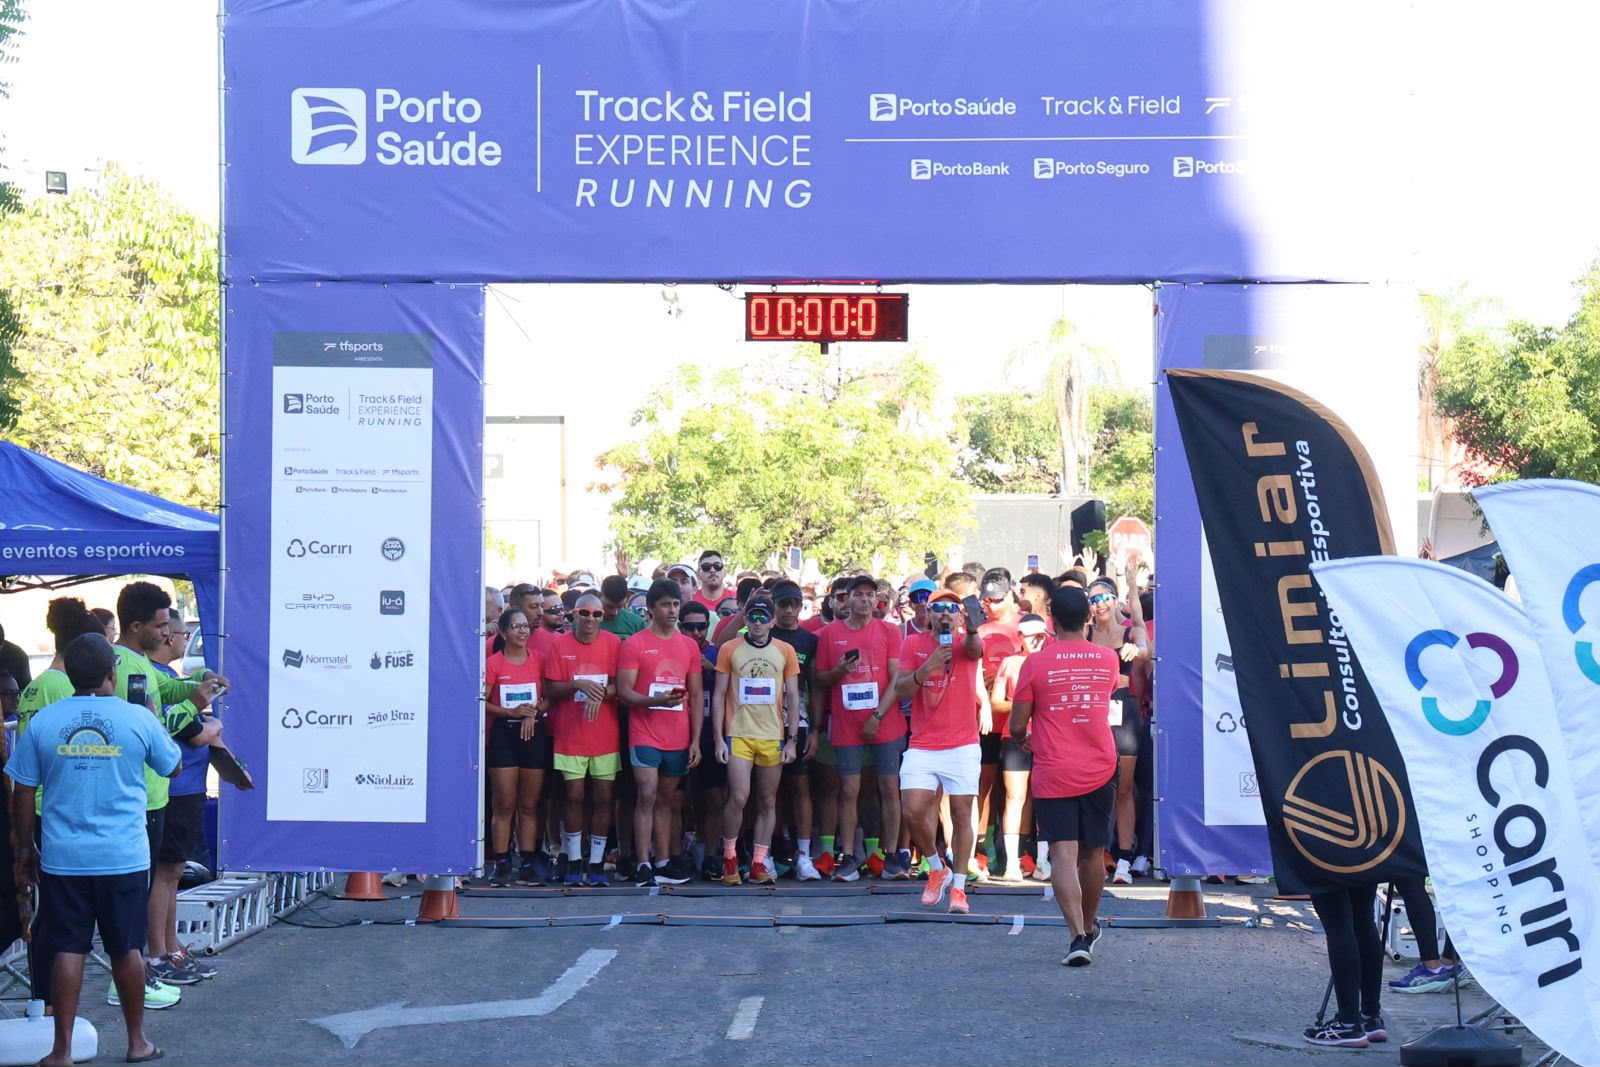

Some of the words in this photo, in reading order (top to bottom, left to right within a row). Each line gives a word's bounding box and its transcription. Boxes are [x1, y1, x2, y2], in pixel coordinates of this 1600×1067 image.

[376, 88, 481, 123] Porto
[376, 130, 502, 167] Saúde
[575, 134, 812, 167] EXPERIENCE
[575, 178, 812, 209] RUNNING
[751, 298, 877, 336] 00:00:0
[339, 341, 384, 352] tfsports
[306, 393, 335, 403] Porto
[306, 404, 340, 415] Saúde
[358, 406, 422, 415] EXPERIENCE
[358, 417, 422, 427] RUNNING
[1296, 440, 1330, 564] Esportiva
[3, 543, 78, 559] eventos
[84, 541, 185, 561] esportivos
[308, 540, 352, 554] Cariri
[1242, 422, 1337, 738] Limiar
[302, 593, 335, 601] BYD
[306, 654, 348, 663] Normatel
[1056, 652, 1101, 660] RUNNING
[305, 710, 352, 725] Cariri
[367, 711, 388, 725] São
[390, 709, 415, 721] Braz
[1476, 734, 1582, 988] Cariri
[1466, 813, 1511, 935] SHOPPING
